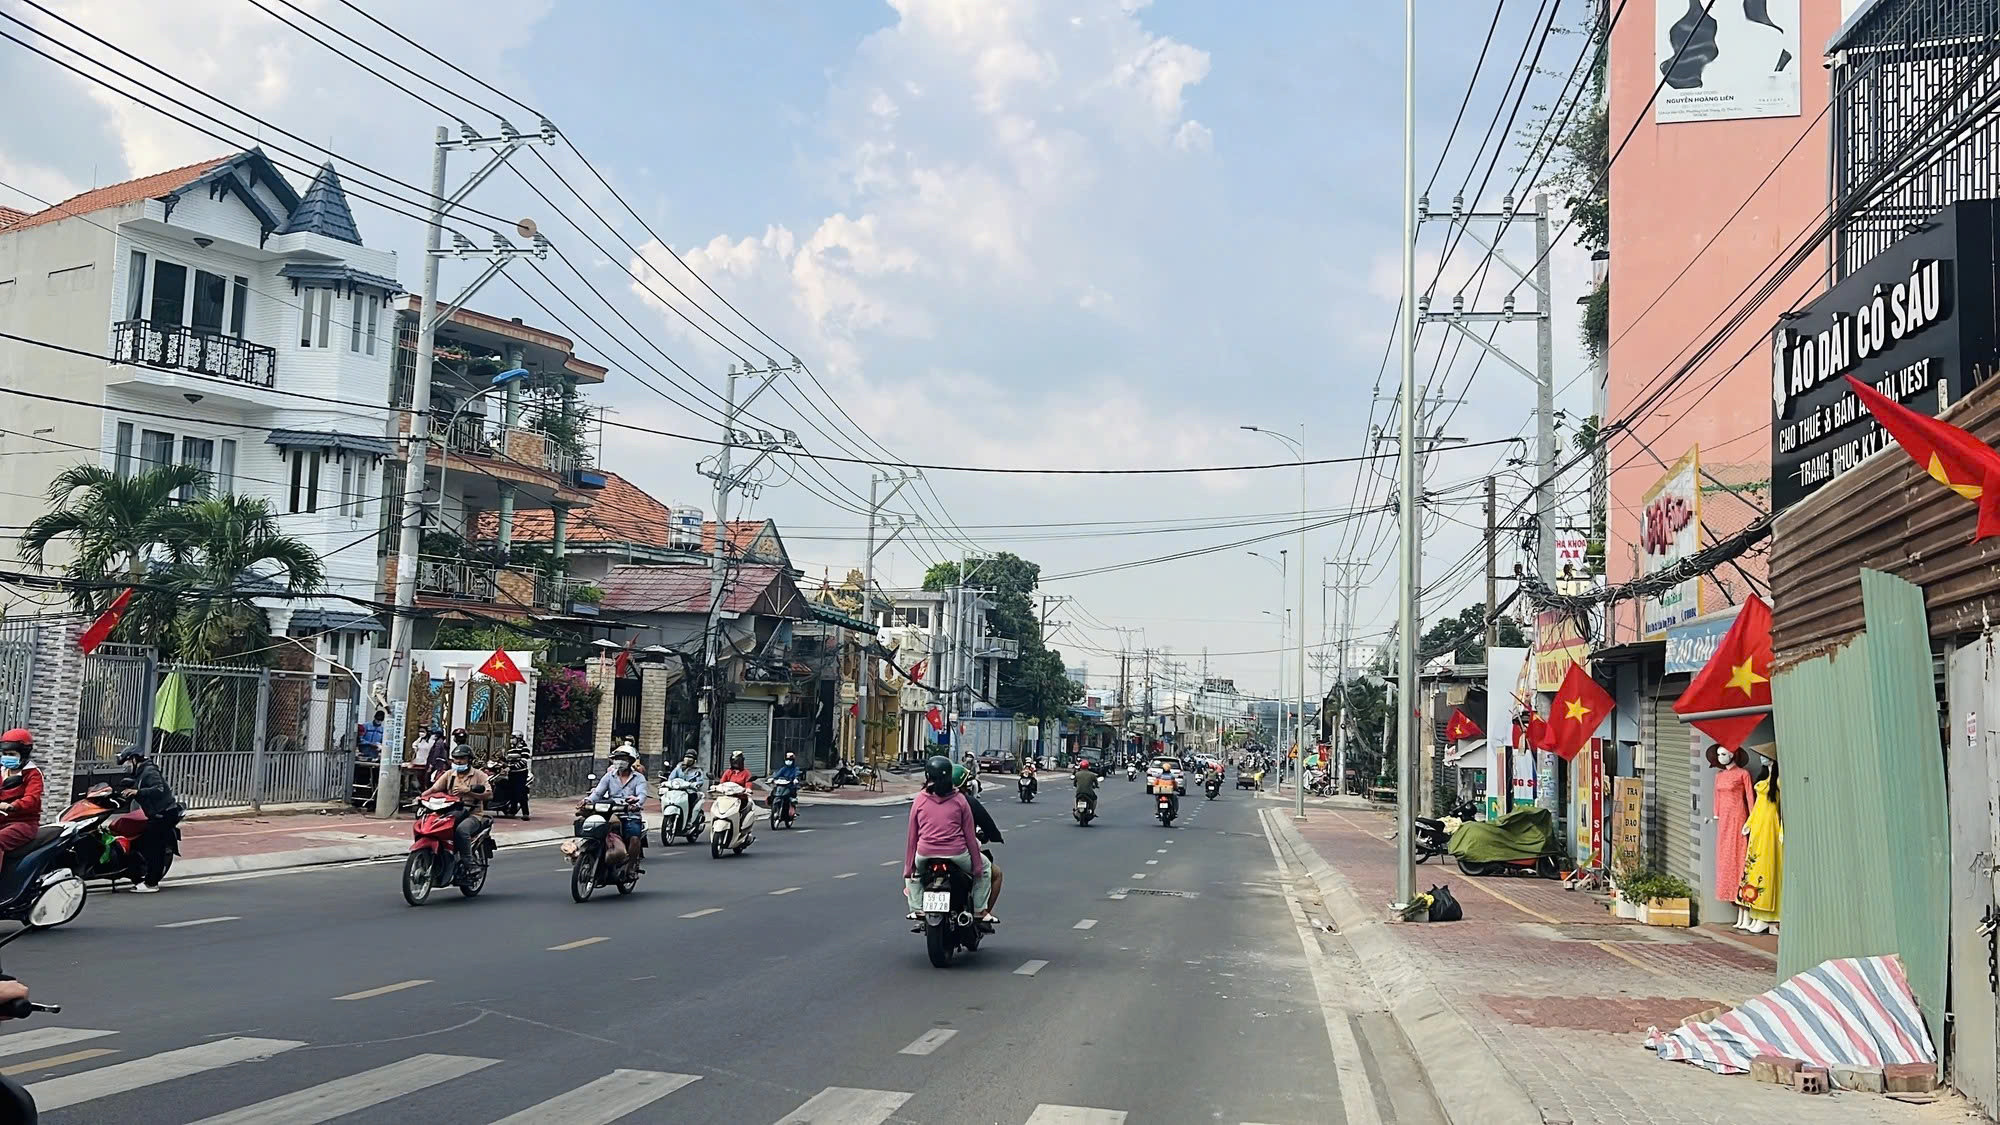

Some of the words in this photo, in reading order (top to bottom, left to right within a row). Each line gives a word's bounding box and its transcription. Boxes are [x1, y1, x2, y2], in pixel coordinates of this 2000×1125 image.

[1791, 335, 1813, 396] ÁO
[1818, 312, 1849, 381] DÀI
[1857, 284, 1885, 358] CÔ
[1891, 259, 1939, 340] SÁU
[1779, 428, 1796, 453] CHO
[1799, 405, 1821, 444] THUÊ
[1824, 408, 1832, 433] &
[1835, 391, 1855, 428] BÁN
[1900, 358, 1929, 397] VEST
[1800, 452, 1829, 487] TRANG
[1568, 539, 1586, 548] KHOA
